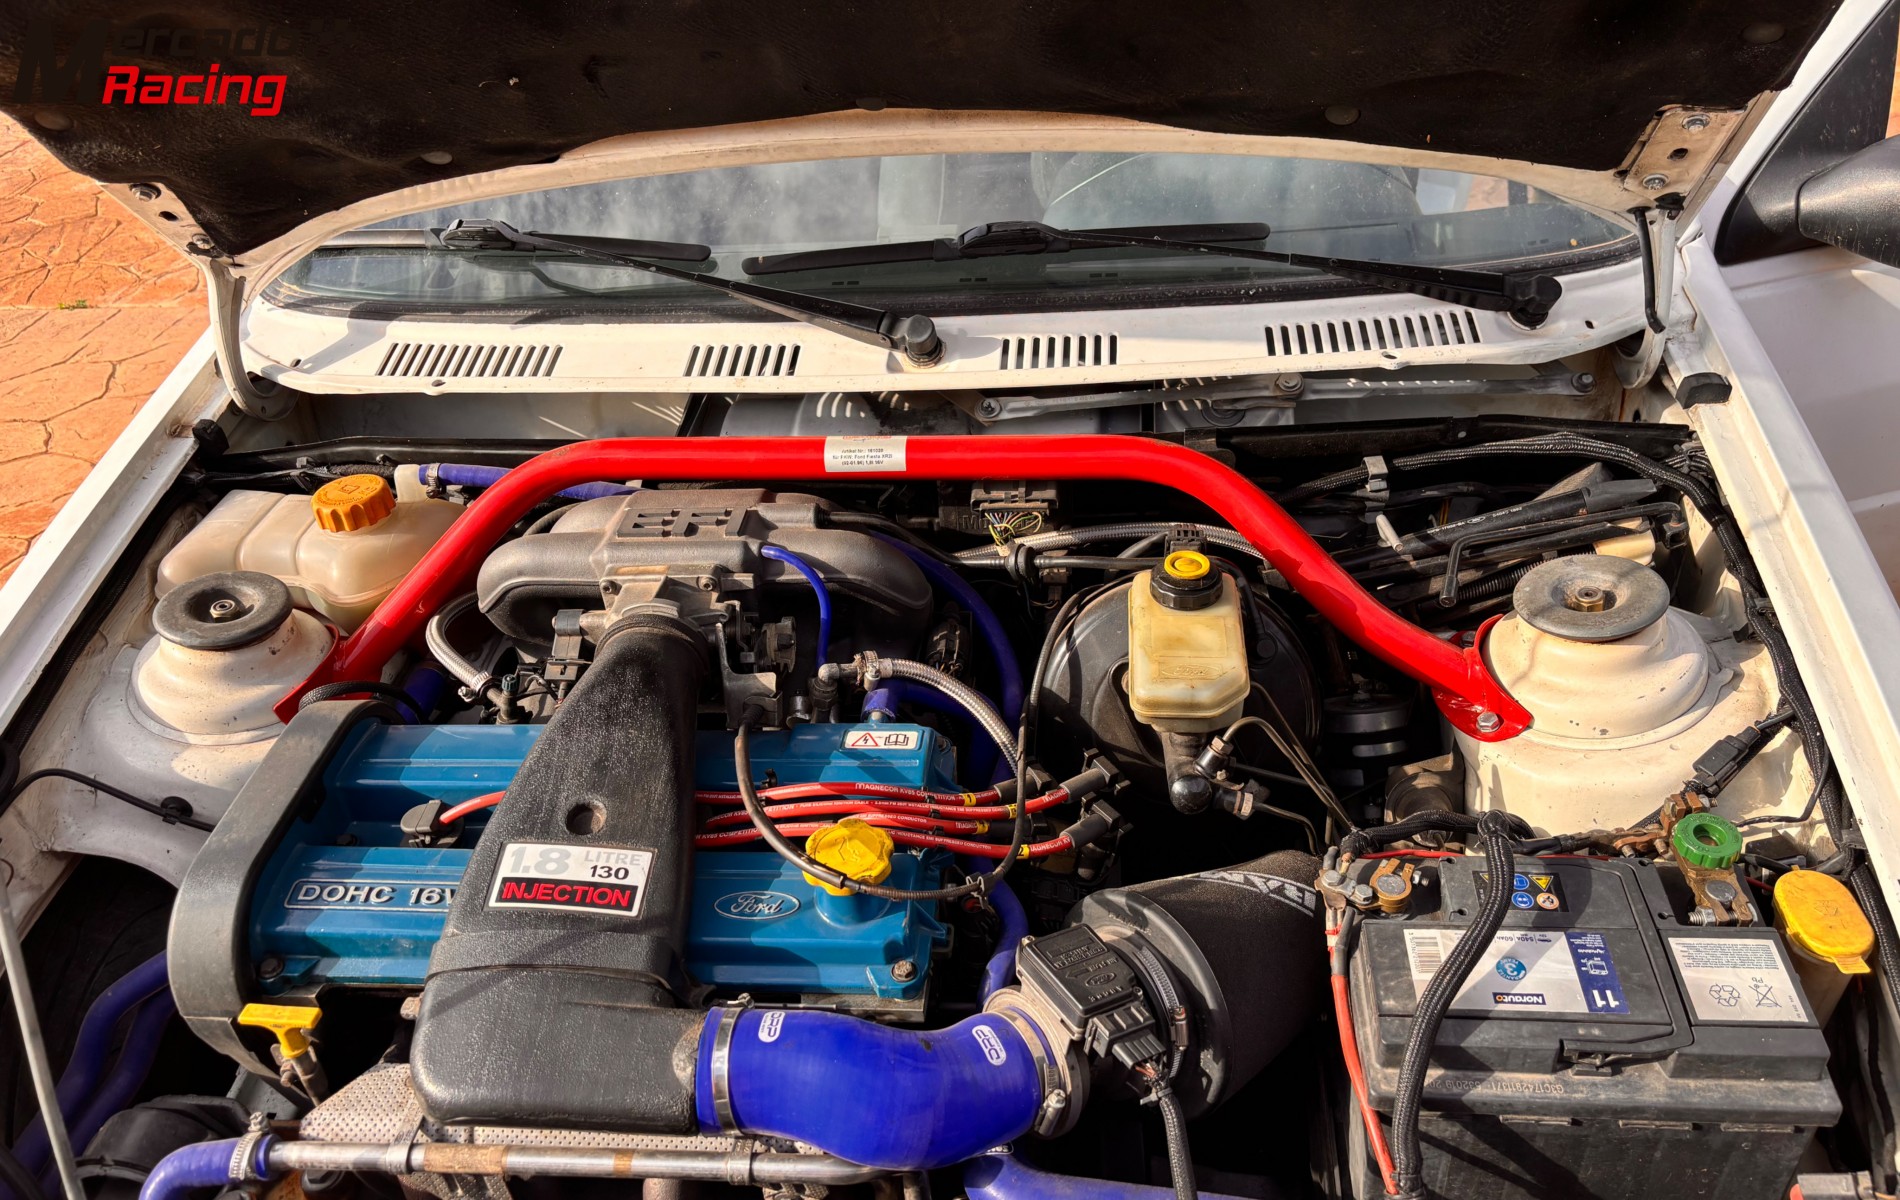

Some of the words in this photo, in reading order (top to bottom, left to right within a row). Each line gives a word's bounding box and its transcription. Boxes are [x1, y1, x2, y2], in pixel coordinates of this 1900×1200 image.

[617, 507, 748, 538] EFI
[855, 782, 899, 793] MAGNECOR
[900, 787, 915, 796] KV85
[897, 815, 927, 823] CONDUCTOR
[964, 842, 992, 850] CONDUCTOR
[510, 846, 571, 875] 1.8
[583, 850, 643, 867] LITRE
[590, 864, 630, 881] 130
[297, 884, 393, 904] DOHC
[501, 882, 632, 908] INJECTION
[730, 893, 785, 915] Ford
[1504, 962, 1518, 976] 3
[1751, 976, 1764, 984] Pb
[1495, 994, 1543, 1004] Norauto
[1592, 989, 1620, 1008] 11
